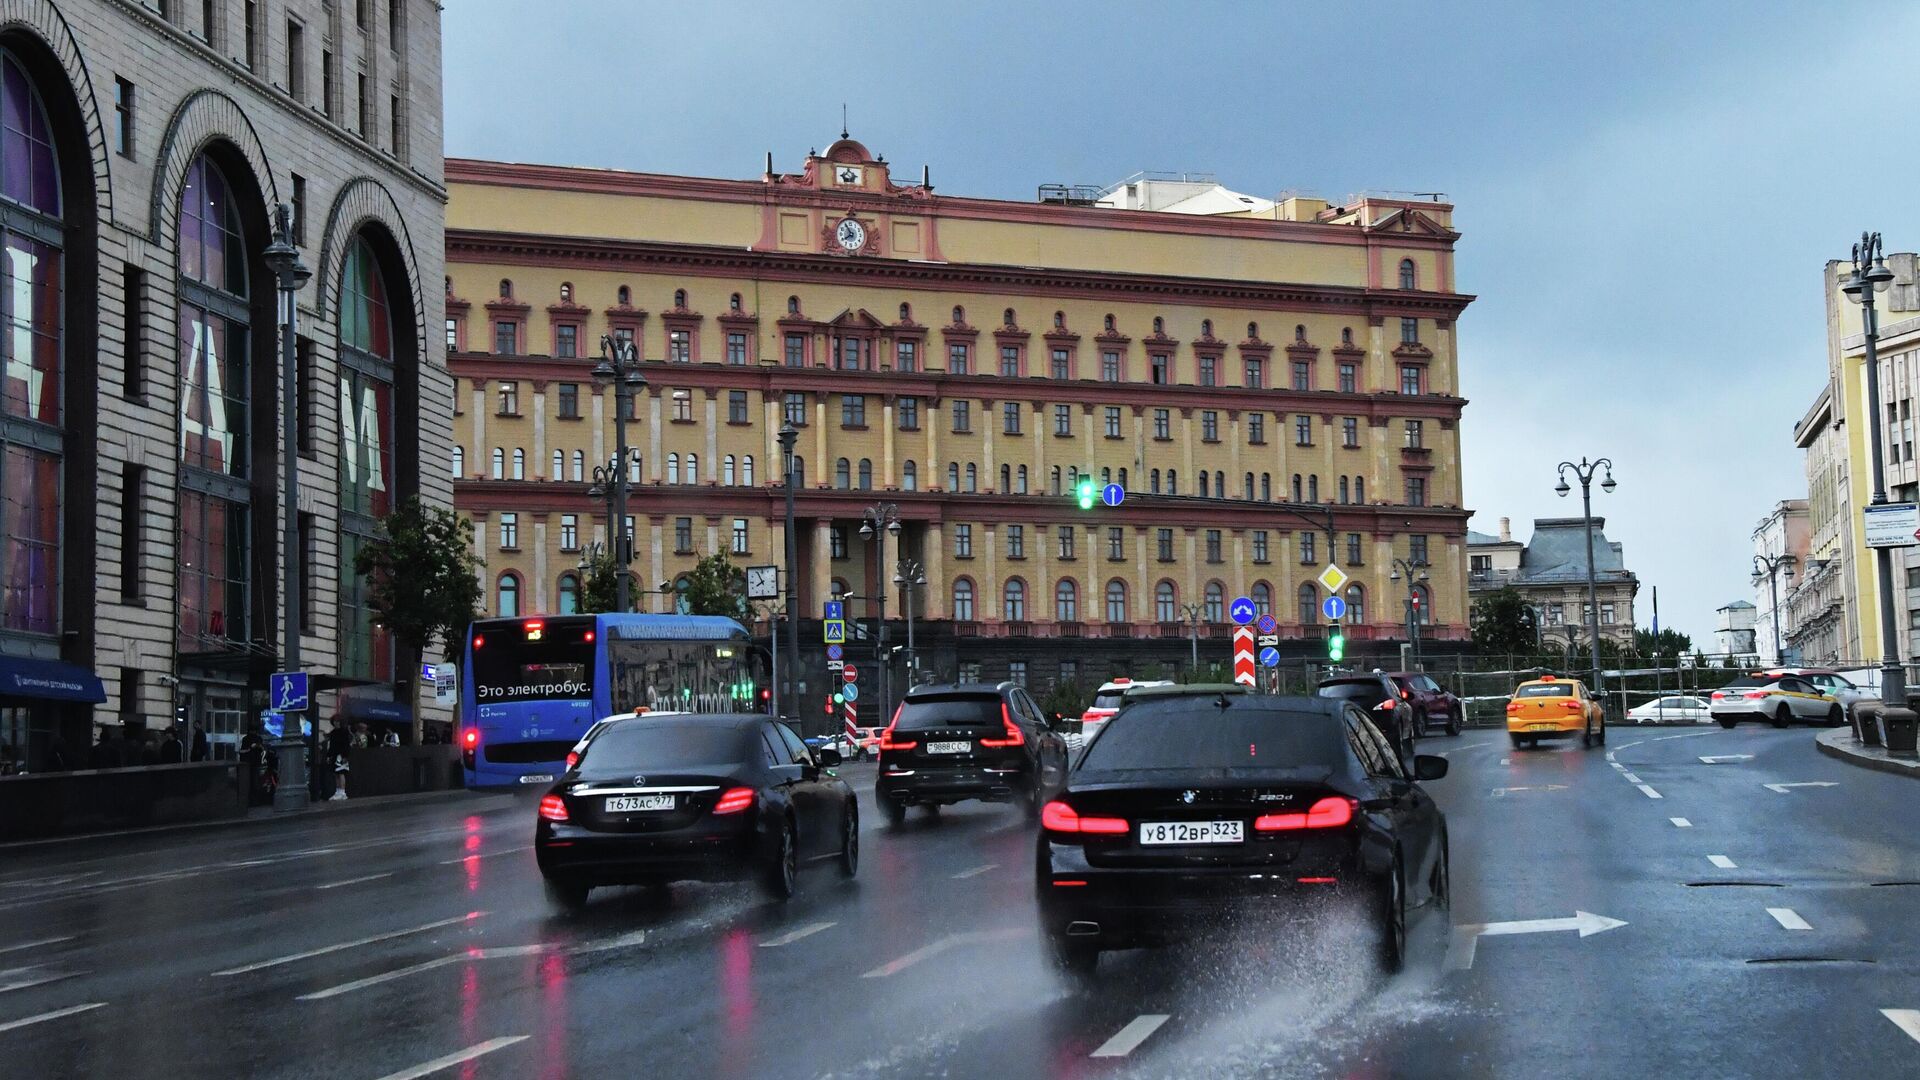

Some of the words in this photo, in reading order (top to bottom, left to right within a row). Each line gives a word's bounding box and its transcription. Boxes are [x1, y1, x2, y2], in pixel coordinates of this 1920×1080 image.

[478, 685, 504, 698] Это
[507, 680, 591, 696] электробус.
[1213, 822, 1239, 836] 323
